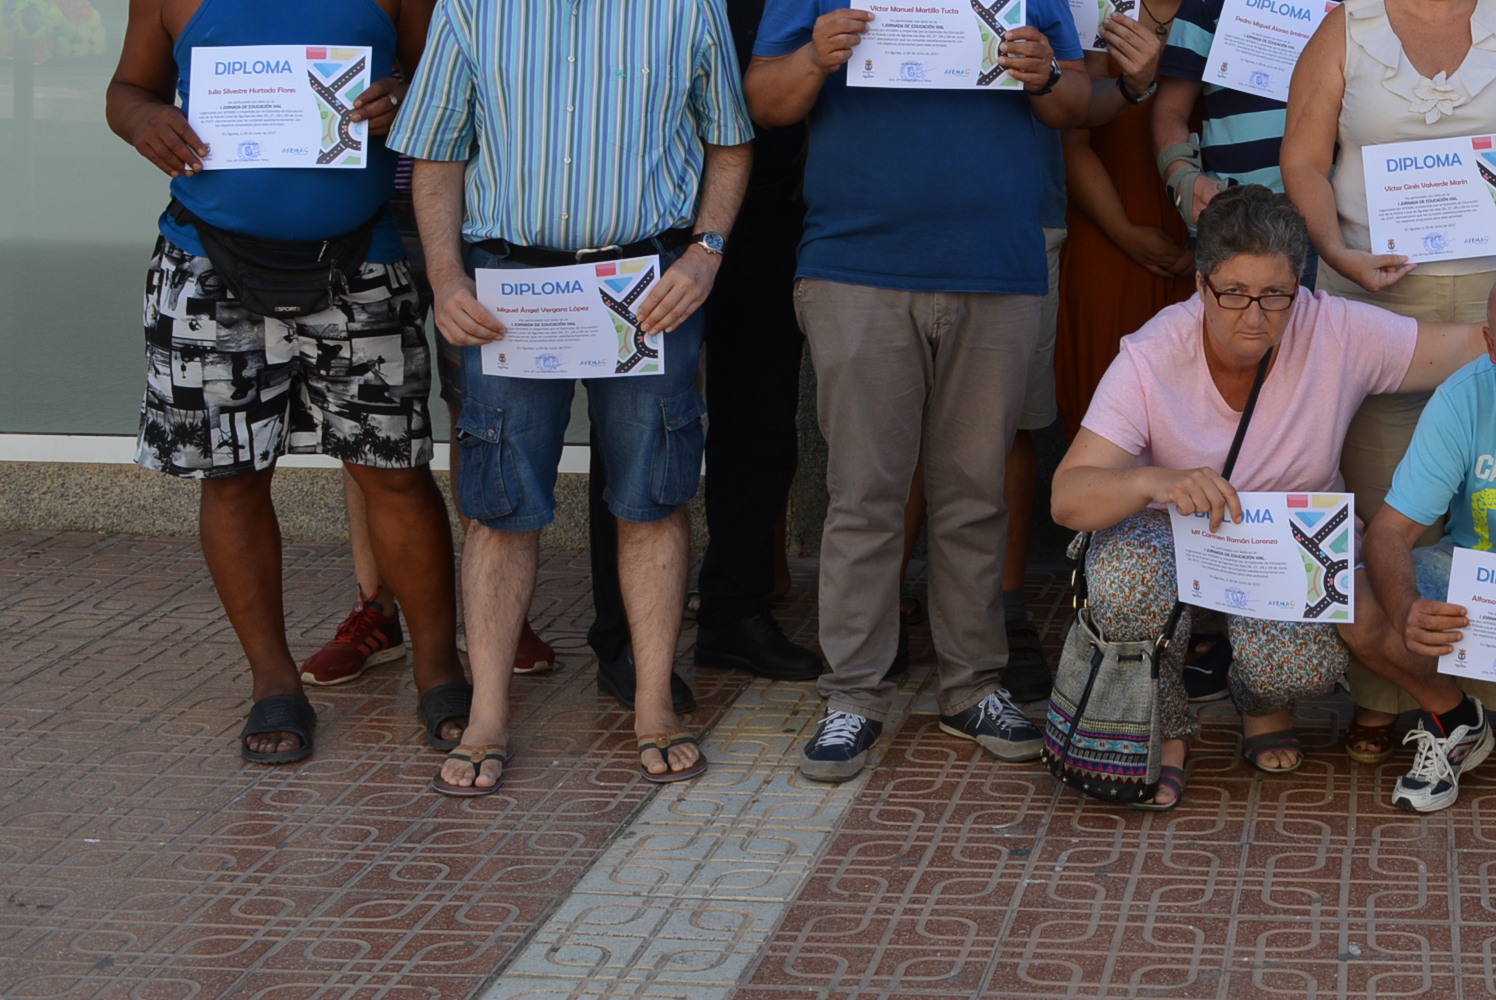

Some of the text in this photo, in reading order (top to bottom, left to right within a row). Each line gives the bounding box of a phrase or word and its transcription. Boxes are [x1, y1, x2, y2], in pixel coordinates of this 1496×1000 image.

[1236, 16, 1252, 25] Pedro
[1252, 20, 1271, 30] Miguel
[1272, 25, 1289, 35] Alonso
[215, 60, 292, 75] DIPLOMA
[1386, 152, 1462, 172] DIPLOMA
[501, 280, 584, 296] DIPLOMA
[1202, 531, 1225, 540] Carmen
[1226, 536, 1250, 544] Román
[1472, 594, 1496, 605] Alfonso
